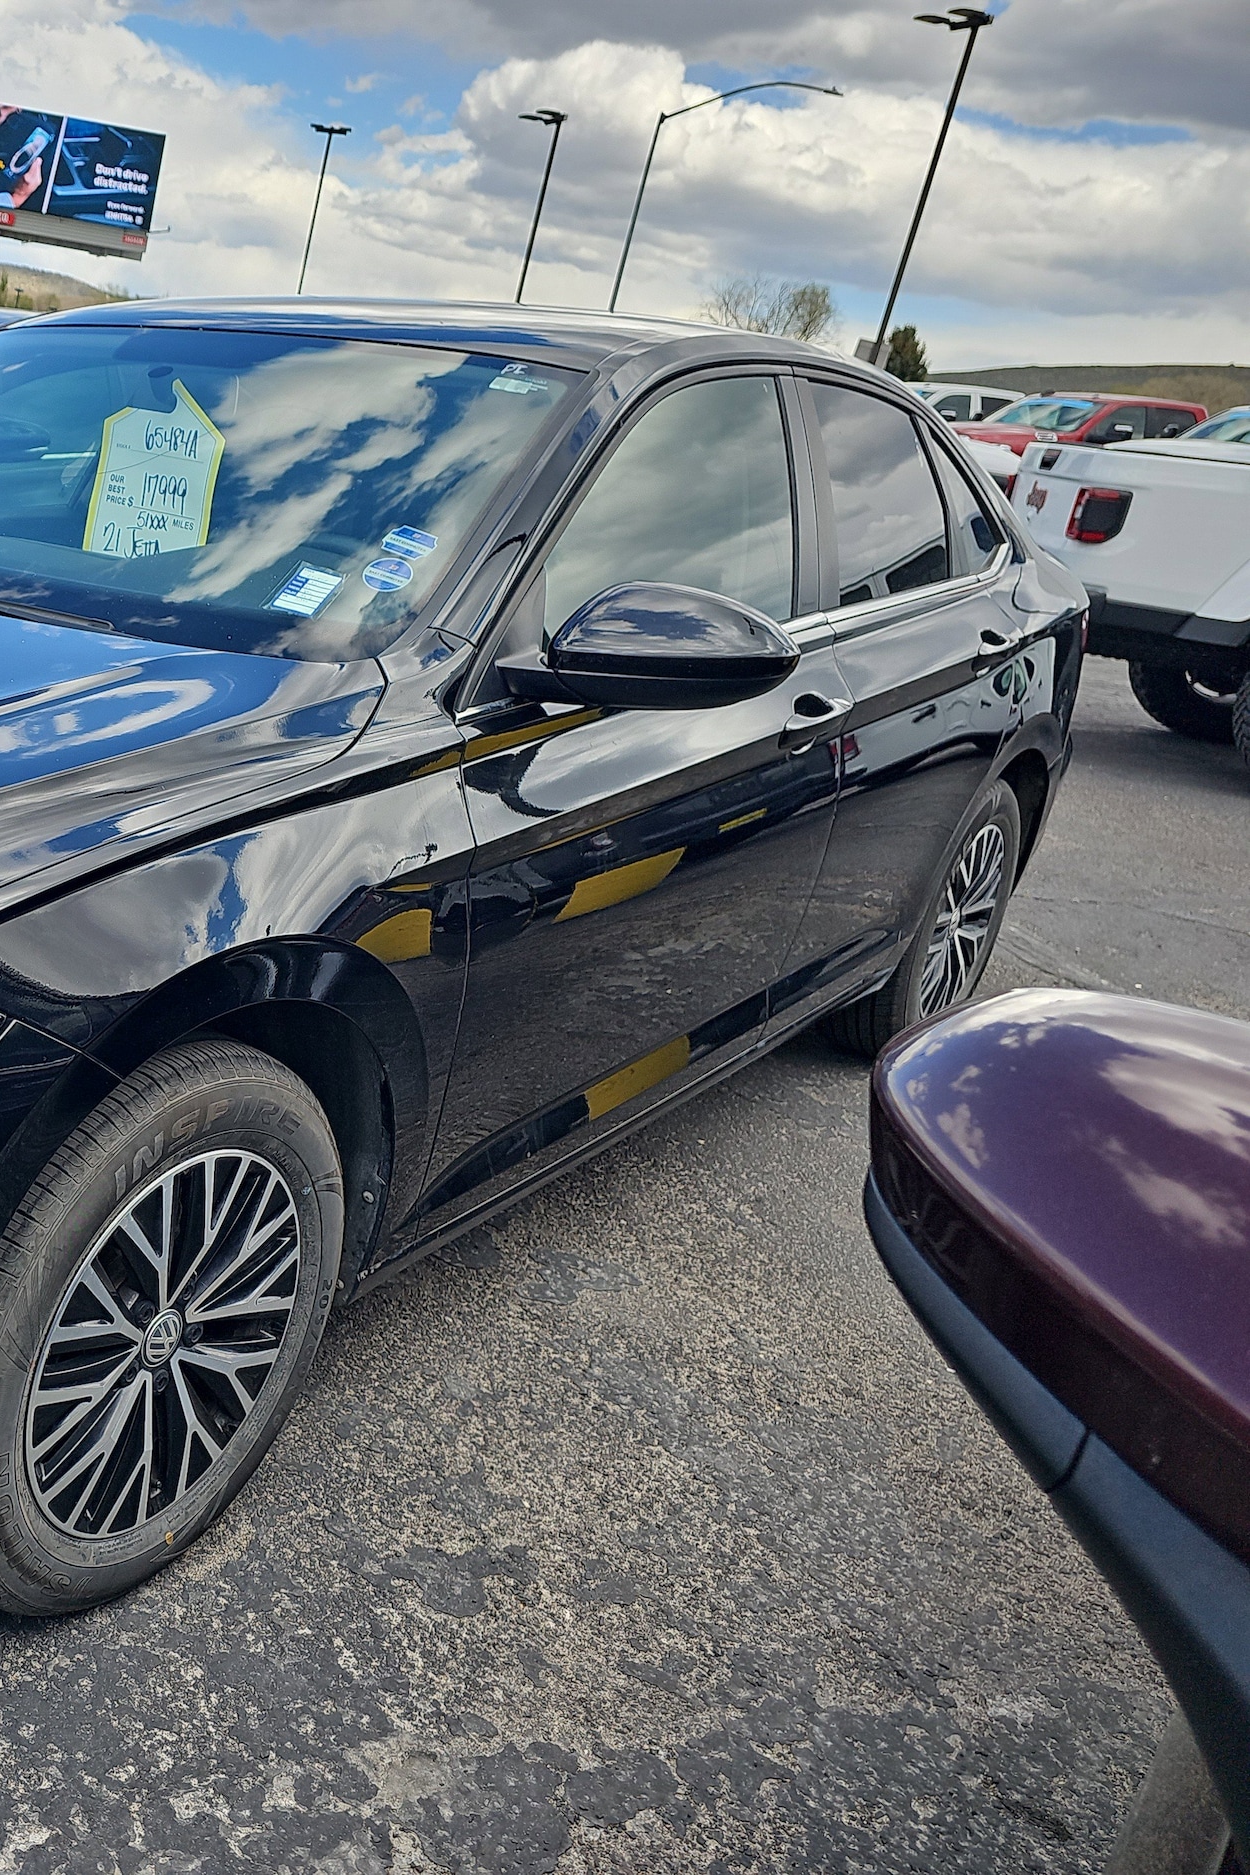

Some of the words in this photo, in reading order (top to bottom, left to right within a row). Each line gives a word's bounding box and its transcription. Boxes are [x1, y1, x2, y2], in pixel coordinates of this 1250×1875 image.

[145, 419, 199, 459] 65484A
[107, 483, 125, 494] BEST
[110, 473, 125, 484] OUR
[105, 495, 127, 506] PRICE
[141, 472, 188, 516] 17999
[103, 522, 121, 552] 21
[171, 518, 195, 531] MILES
[114, 1096, 304, 1201] INSPIRE
